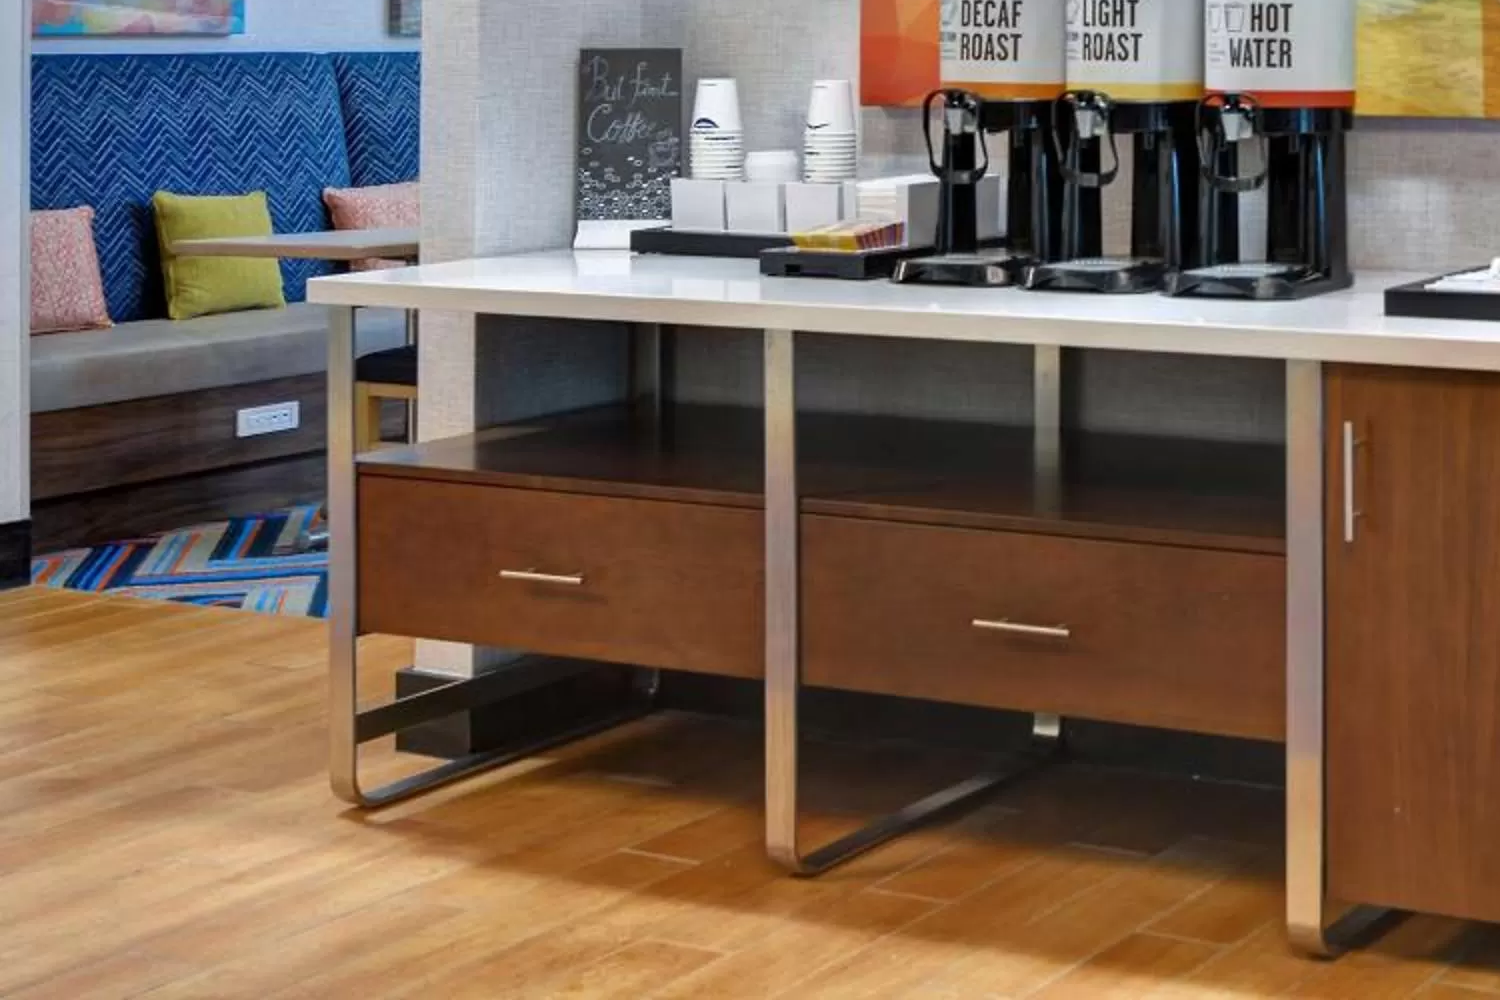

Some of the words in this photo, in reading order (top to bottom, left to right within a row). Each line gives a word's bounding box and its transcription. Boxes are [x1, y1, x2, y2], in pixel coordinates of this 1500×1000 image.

[960, 0, 1024, 29] DECAF
[1250, 3, 1293, 33] HOT
[960, 33, 1023, 62] ROAST
[1082, 32, 1143, 62] ROAST
[1229, 38, 1293, 68] WATER
[586, 103, 658, 144] Coffee
